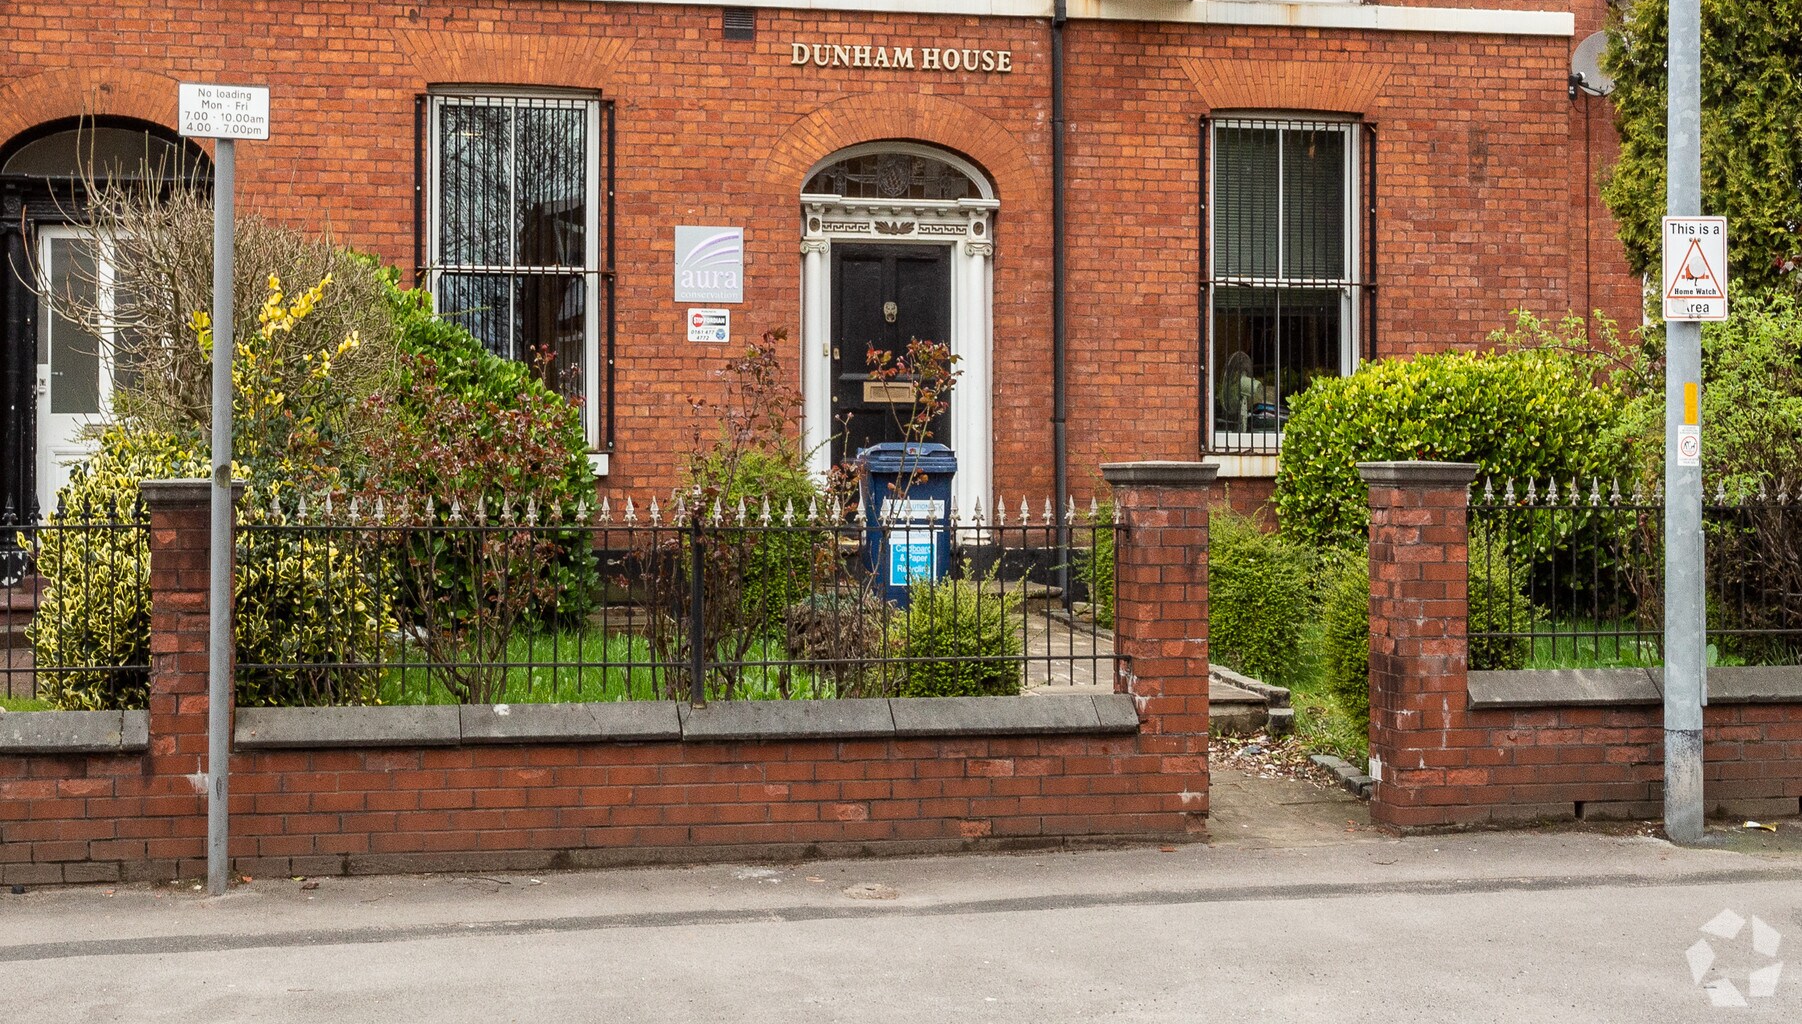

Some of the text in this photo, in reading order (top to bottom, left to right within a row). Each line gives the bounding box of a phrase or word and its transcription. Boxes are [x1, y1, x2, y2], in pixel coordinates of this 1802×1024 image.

[791, 42, 1012, 72] DUNHAM HOUSE
[198, 88, 252, 101] No loading
[201, 100, 222, 110] Mon
[235, 102, 248, 111] Fri
[185, 111, 208, 121] 7.00
[221, 113, 264, 123] 10.00am
[186, 122, 211, 132] 4.00
[223, 124, 262, 135] 7.00pm
[1669, 223, 1720, 235] This is a
[680, 269, 738, 289] aura
[1695, 287, 1717, 295] Watch
[899, 553, 928, 563] & Paper
